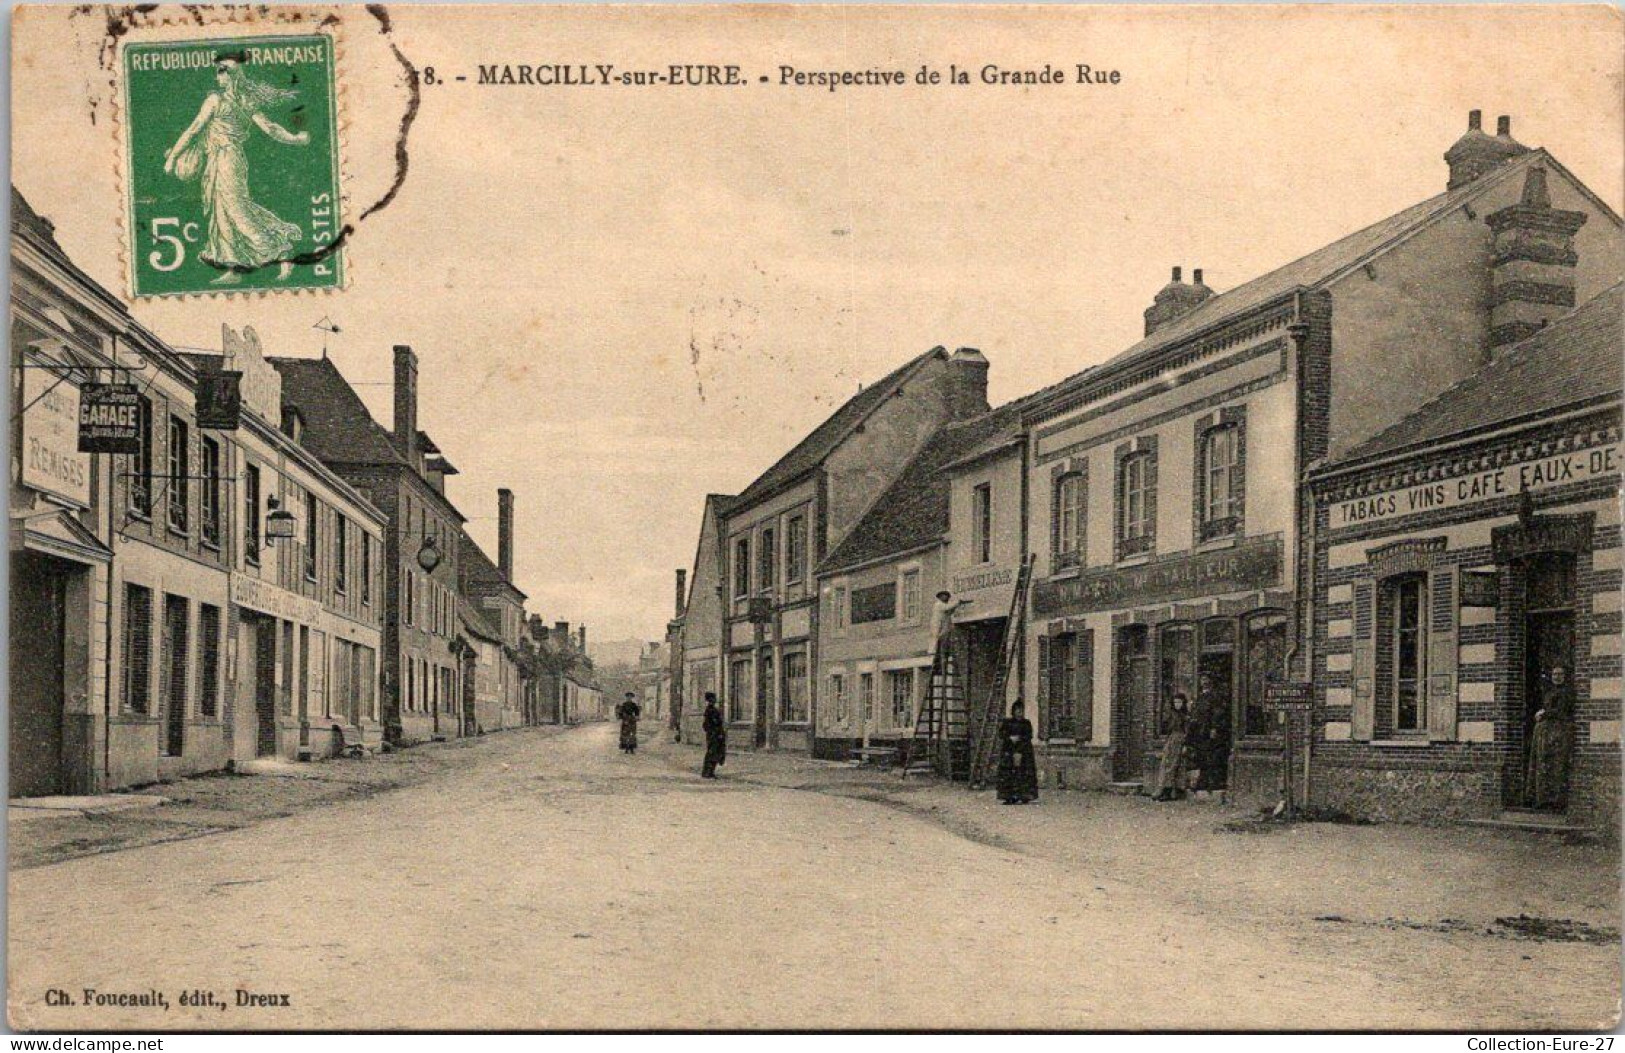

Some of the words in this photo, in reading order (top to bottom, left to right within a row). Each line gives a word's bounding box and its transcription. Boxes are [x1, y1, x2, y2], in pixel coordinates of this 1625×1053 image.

[478, 64, 748, 86] MARCILLY-sur-EURE.
[778, 65, 905, 92] Perspective
[915, 65, 940, 85] de
[950, 64, 970, 85] la
[980, 64, 1064, 85] Grande
[1075, 64, 1121, 85] Rue
[80, 404, 137, 426] GARAGE
[1341, 494, 1396, 522] TABACS
[1408, 484, 1445, 510] VINS
[44, 988, 76, 1007] Ch.
[82, 988, 170, 1011] Foucault,
[178, 988, 228, 1011] édit.,
[235, 989, 291, 1008] Dreux
